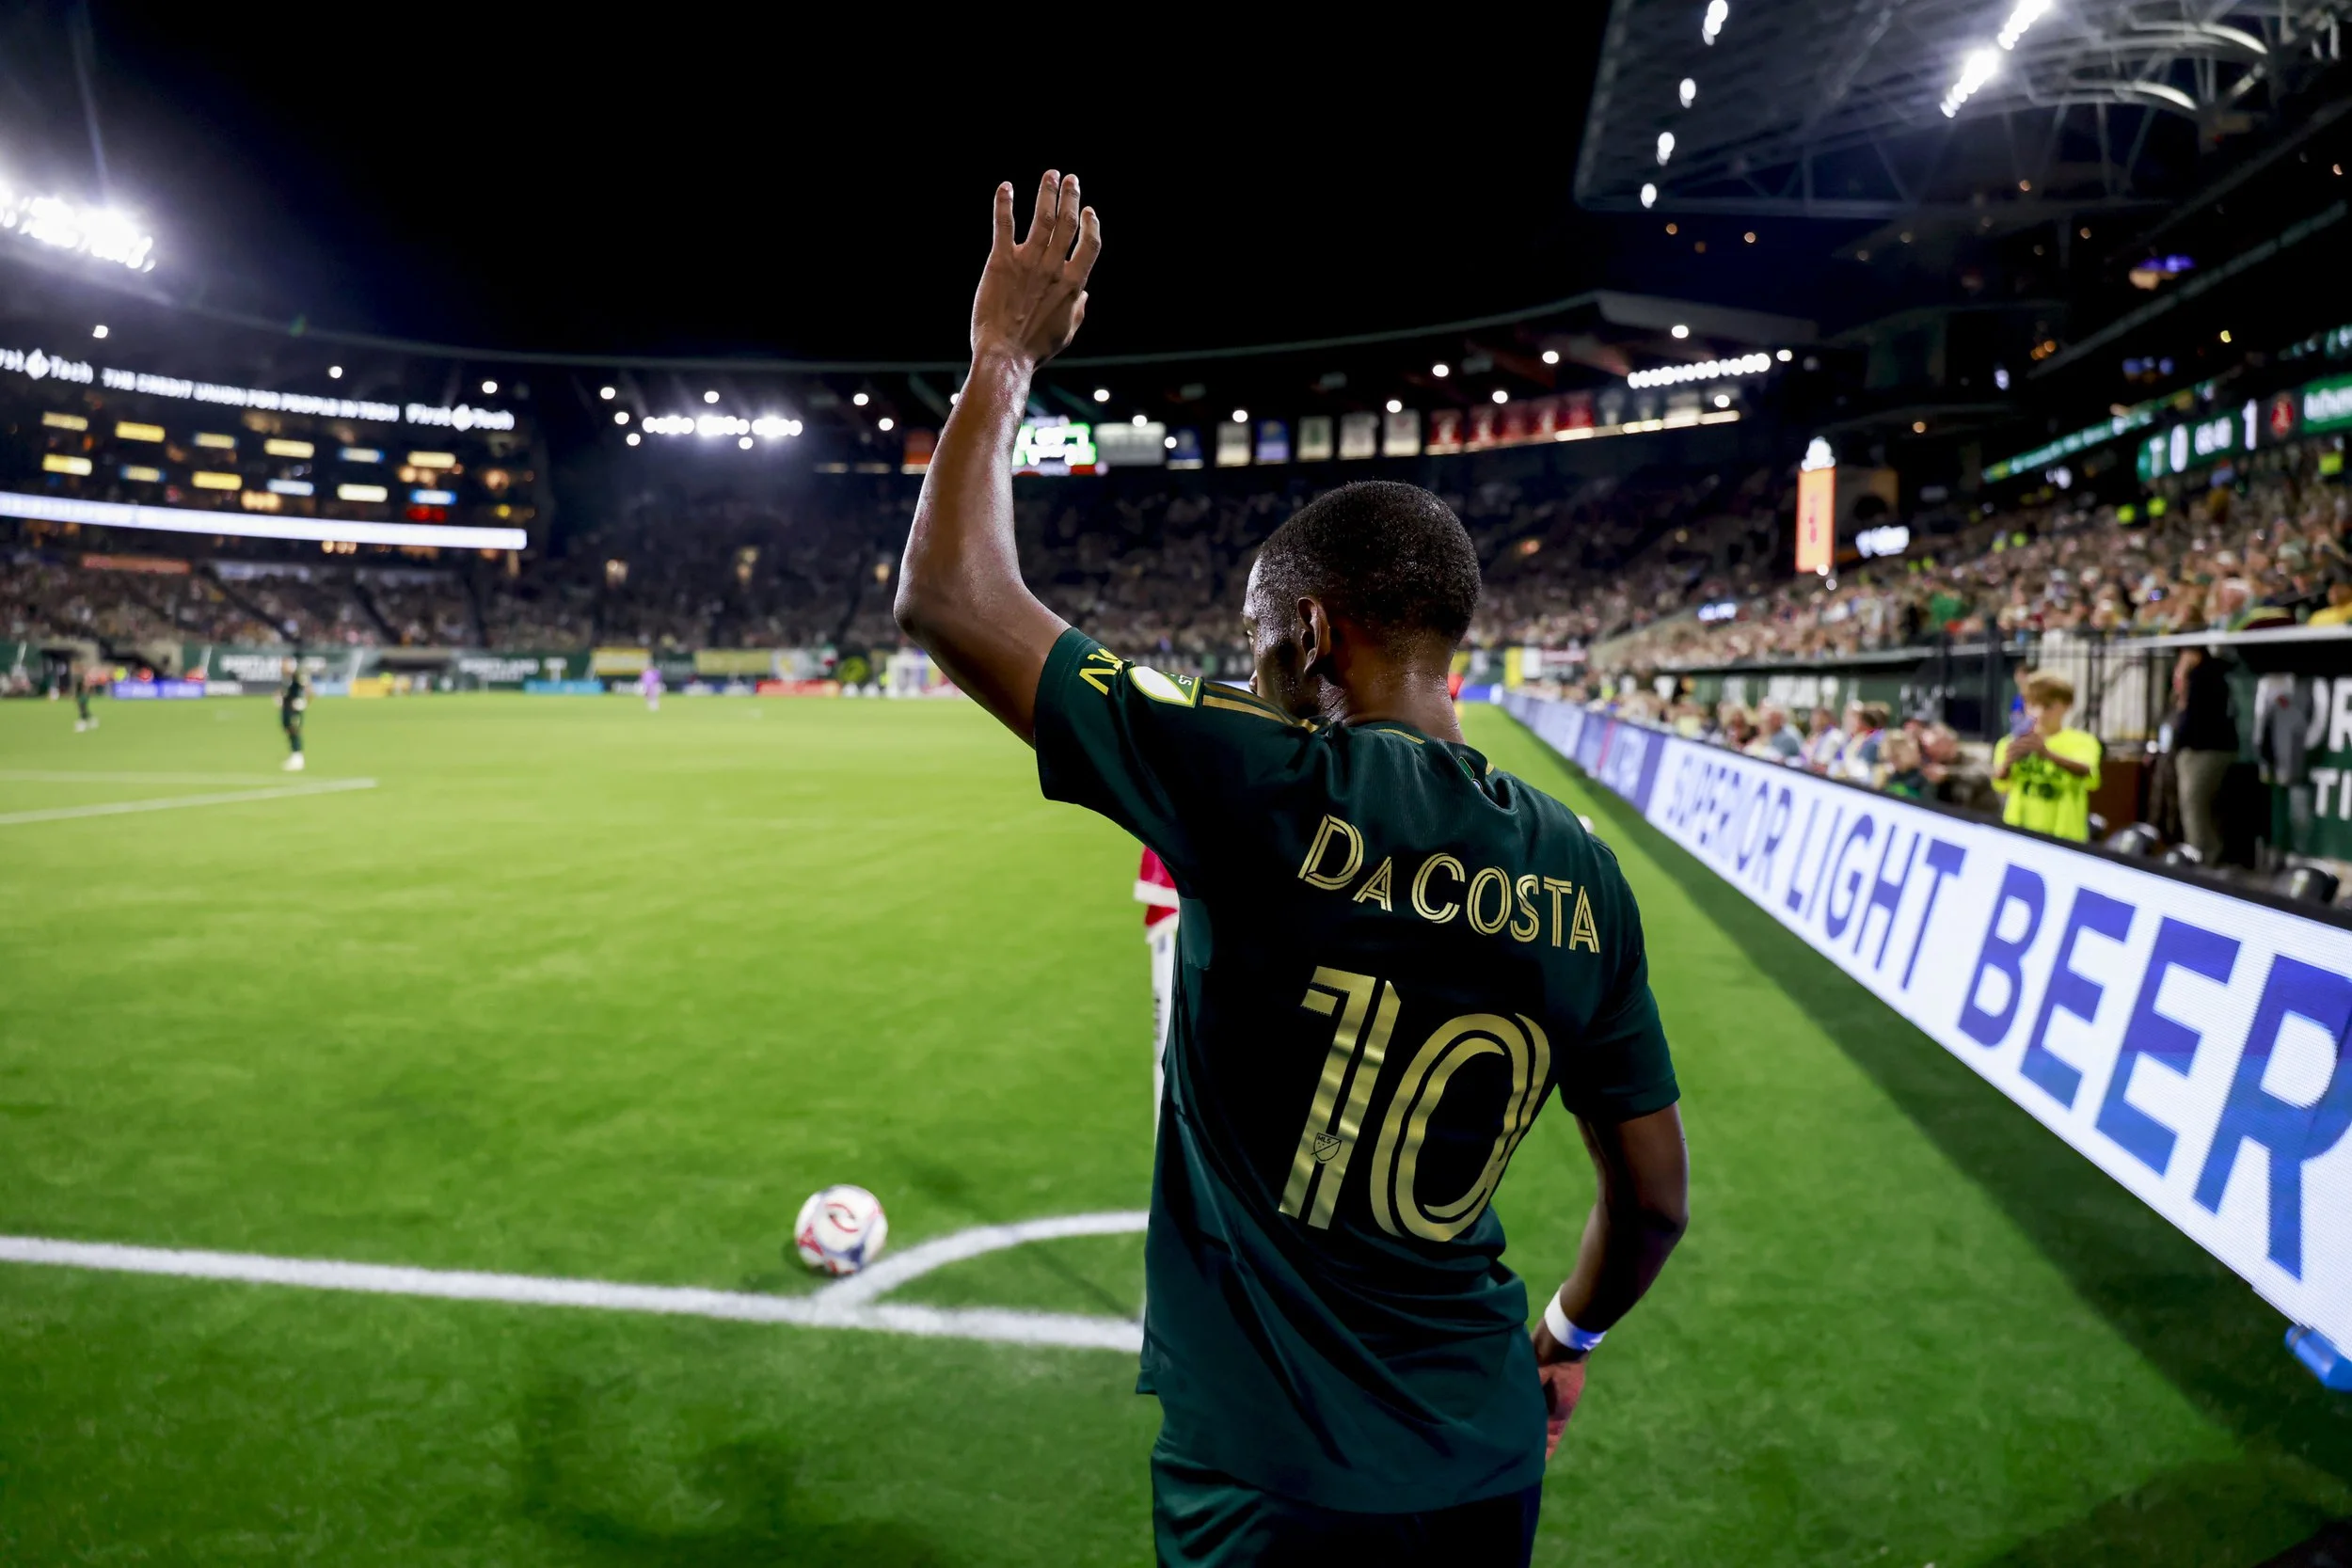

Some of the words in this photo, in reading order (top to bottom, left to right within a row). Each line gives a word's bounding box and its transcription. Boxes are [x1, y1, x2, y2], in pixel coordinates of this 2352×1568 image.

[1411, 852, 1600, 953] COSTA
[1665, 752, 1791, 892] SUPERIOR
[1786, 799, 1967, 991] LIGHT
[1957, 863, 2352, 1281] BEER
[1279, 966, 1550, 1242] 10
